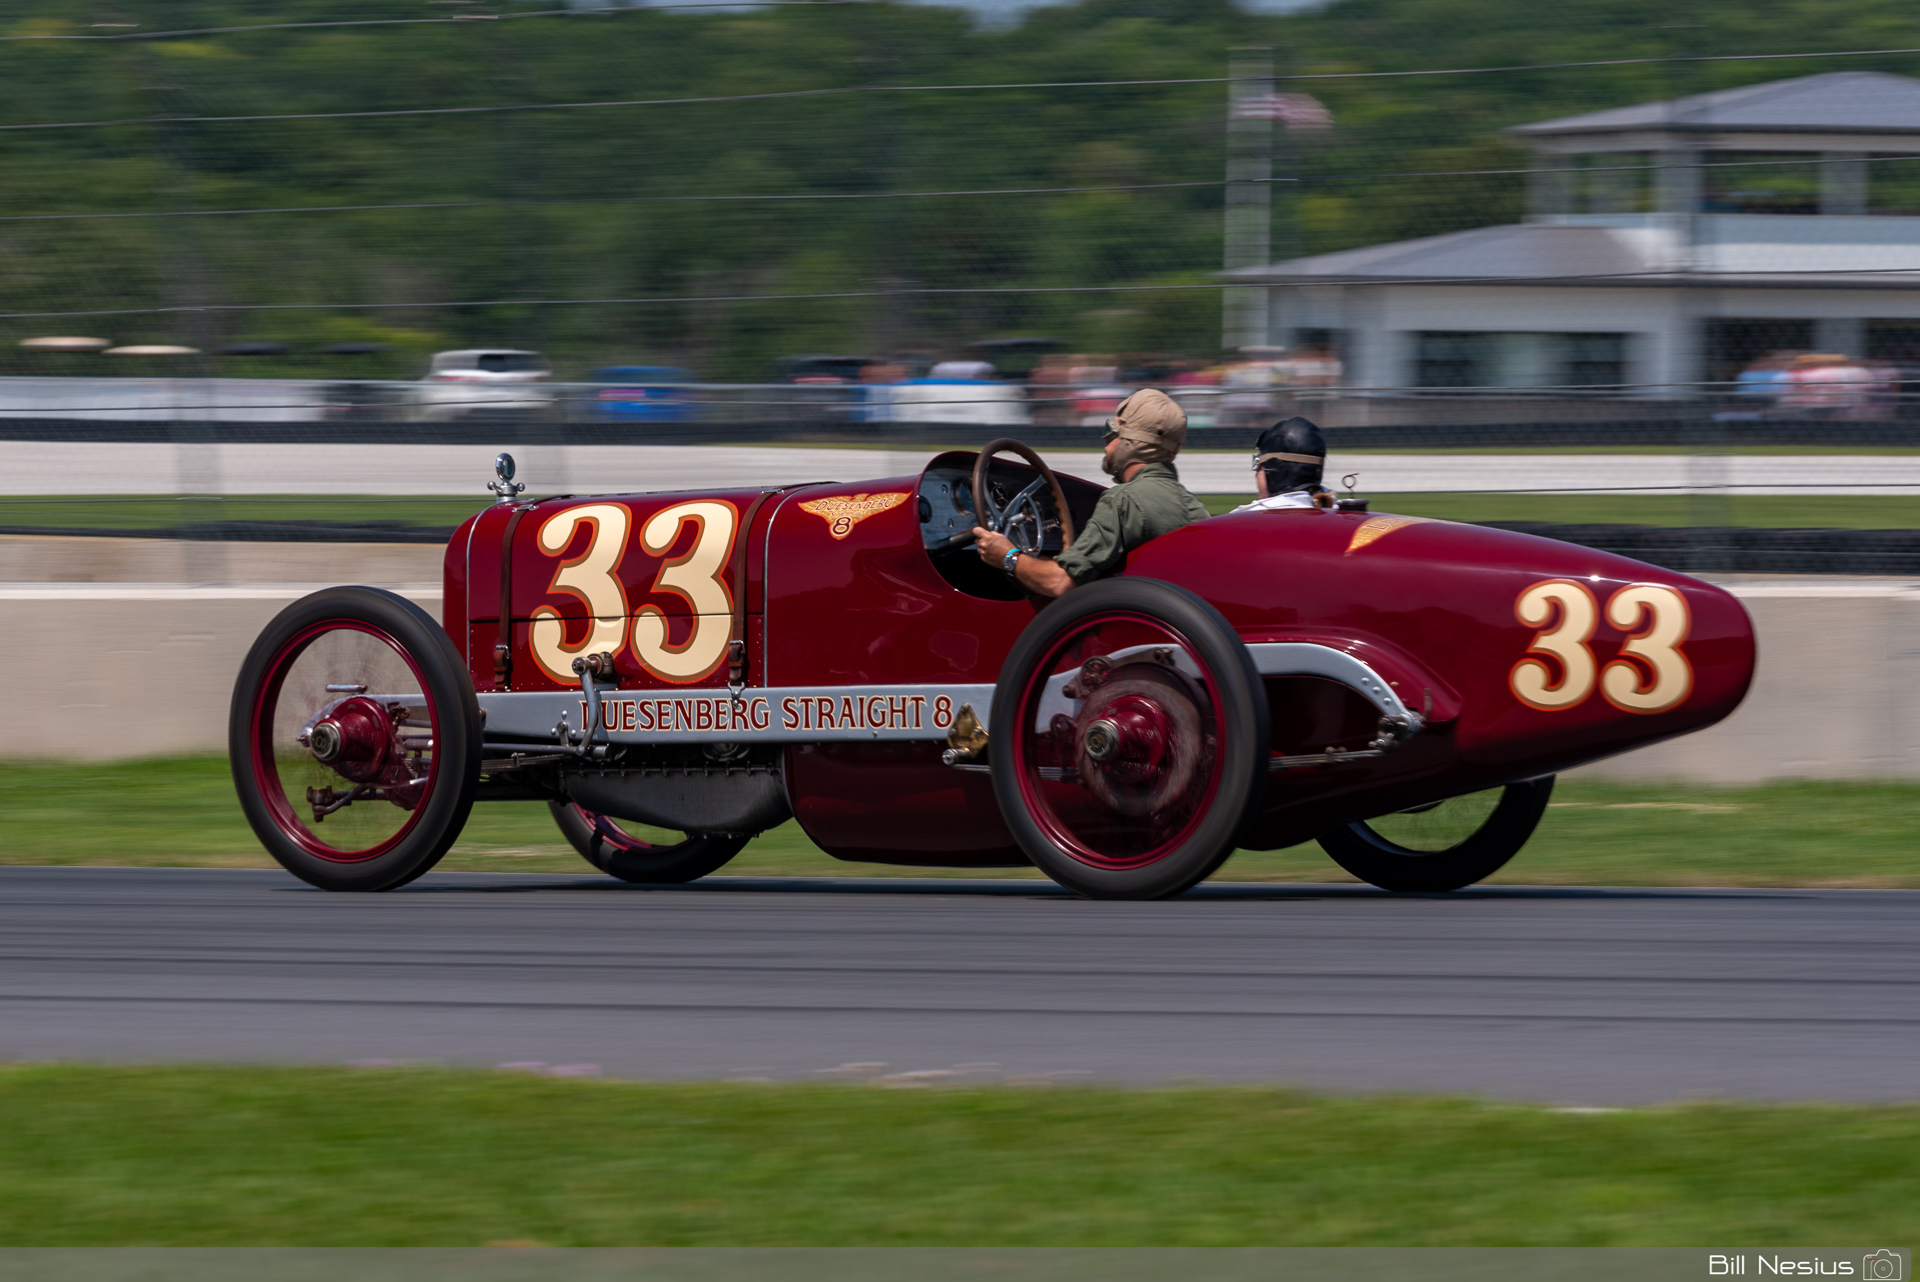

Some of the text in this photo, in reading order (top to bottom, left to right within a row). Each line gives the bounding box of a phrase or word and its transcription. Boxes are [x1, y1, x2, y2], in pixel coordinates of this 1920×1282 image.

[831, 516, 853, 537] 8
[529, 499, 739, 685] 33
[1508, 578, 1695, 715] 33
[782, 695, 928, 731] STRAIGHT
[932, 694, 953, 730] 8
